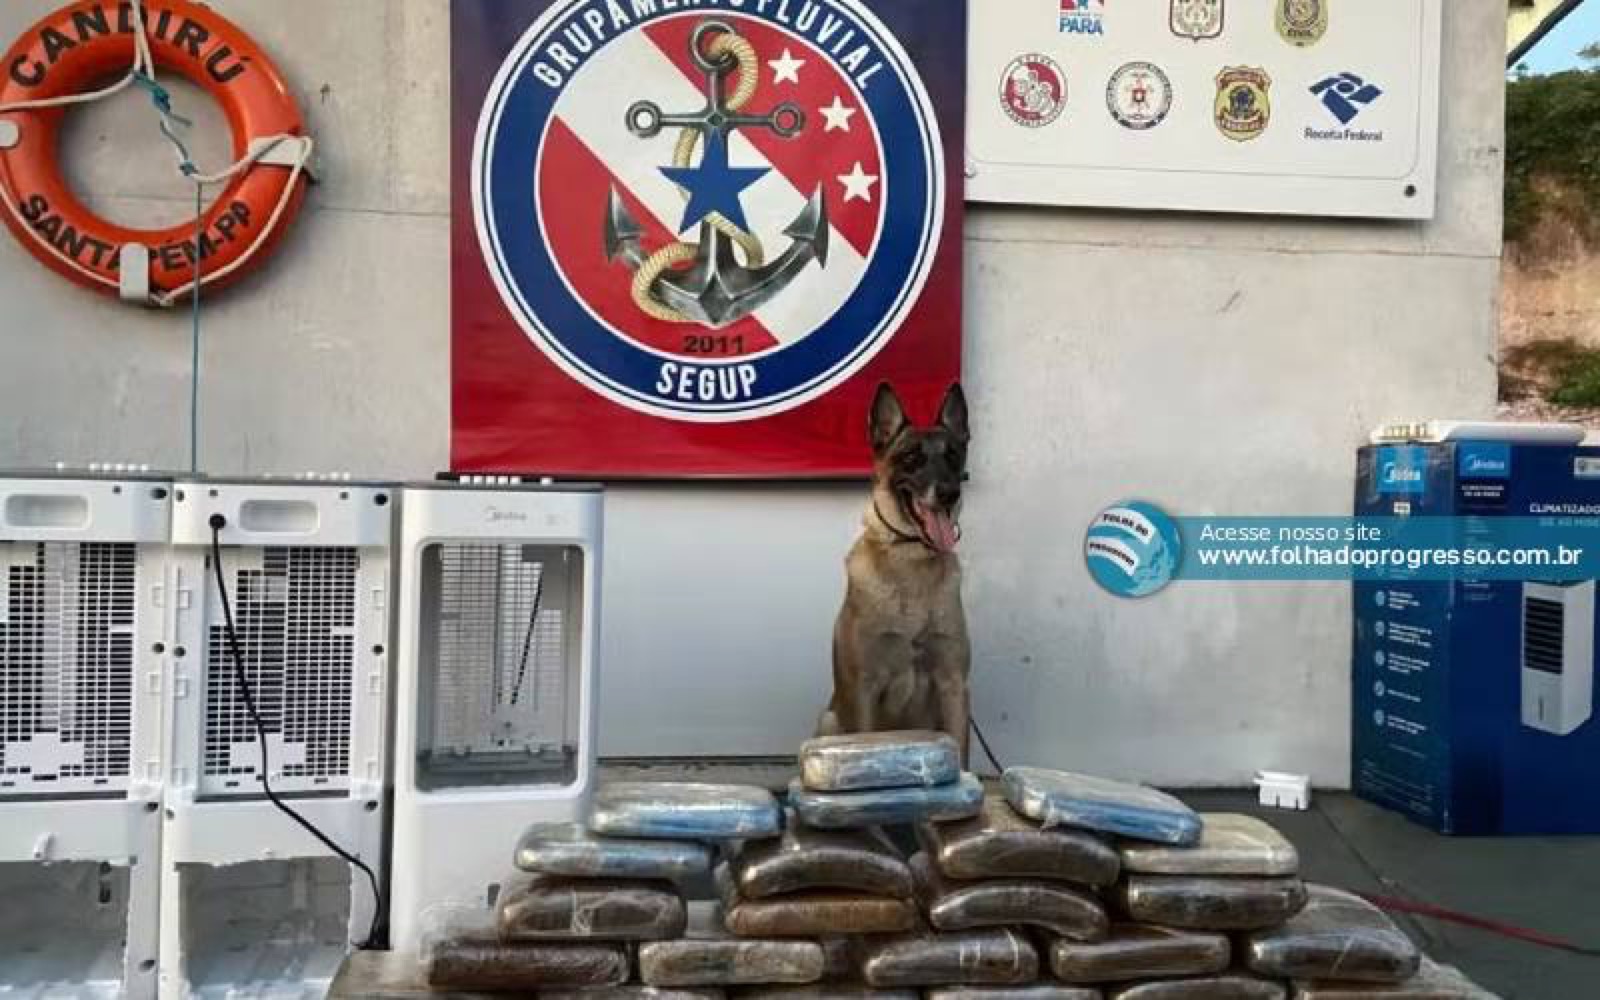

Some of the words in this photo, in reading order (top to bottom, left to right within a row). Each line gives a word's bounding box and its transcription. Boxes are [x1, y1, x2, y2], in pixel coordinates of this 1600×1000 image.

[533, 0, 744, 88] GRUPAM
[19, 194, 250, 271] SANTAÉM-PA
[684, 335, 745, 352] 2011
[656, 361, 757, 401] SEGUP
